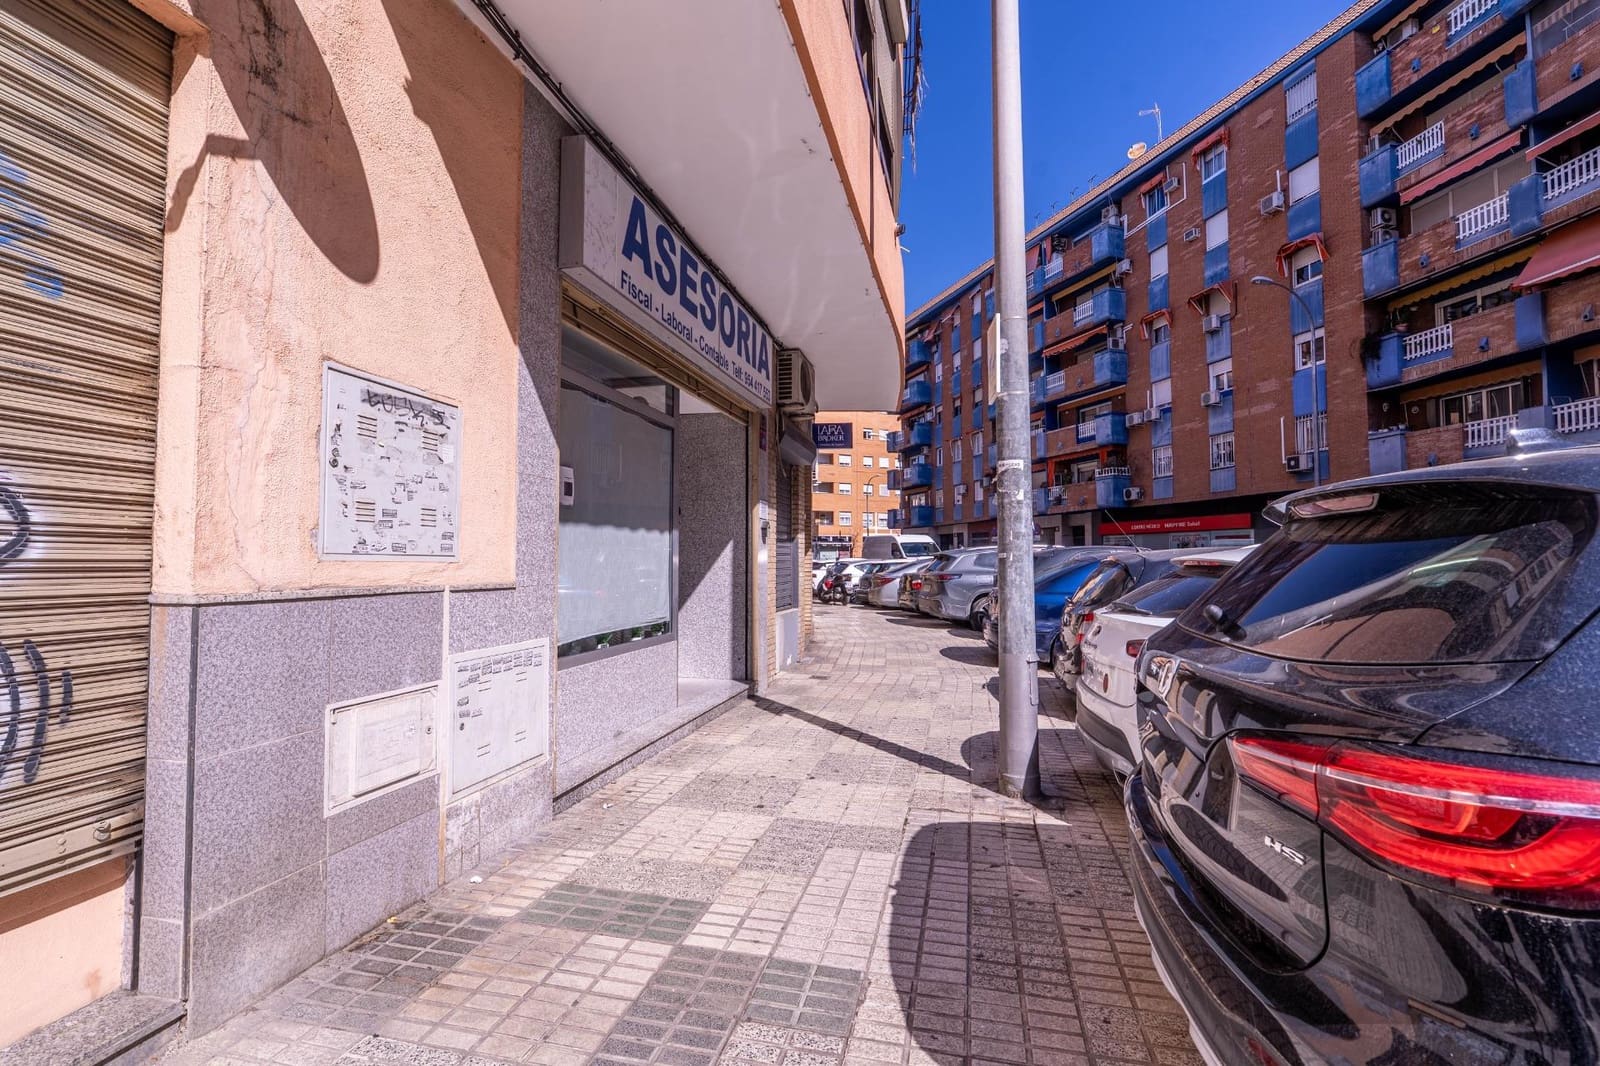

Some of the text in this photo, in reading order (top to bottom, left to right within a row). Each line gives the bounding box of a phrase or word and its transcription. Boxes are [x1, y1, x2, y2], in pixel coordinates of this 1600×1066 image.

[622, 195, 770, 381] ASESORIA
[620, 269, 653, 312] Fiscal
[661, 303, 693, 343] Laboral
[699, 335, 729, 371] Contable
[744, 371, 754, 389] 954
[817, 425, 845, 435] LARA
[1264, 835, 1305, 866] HS
